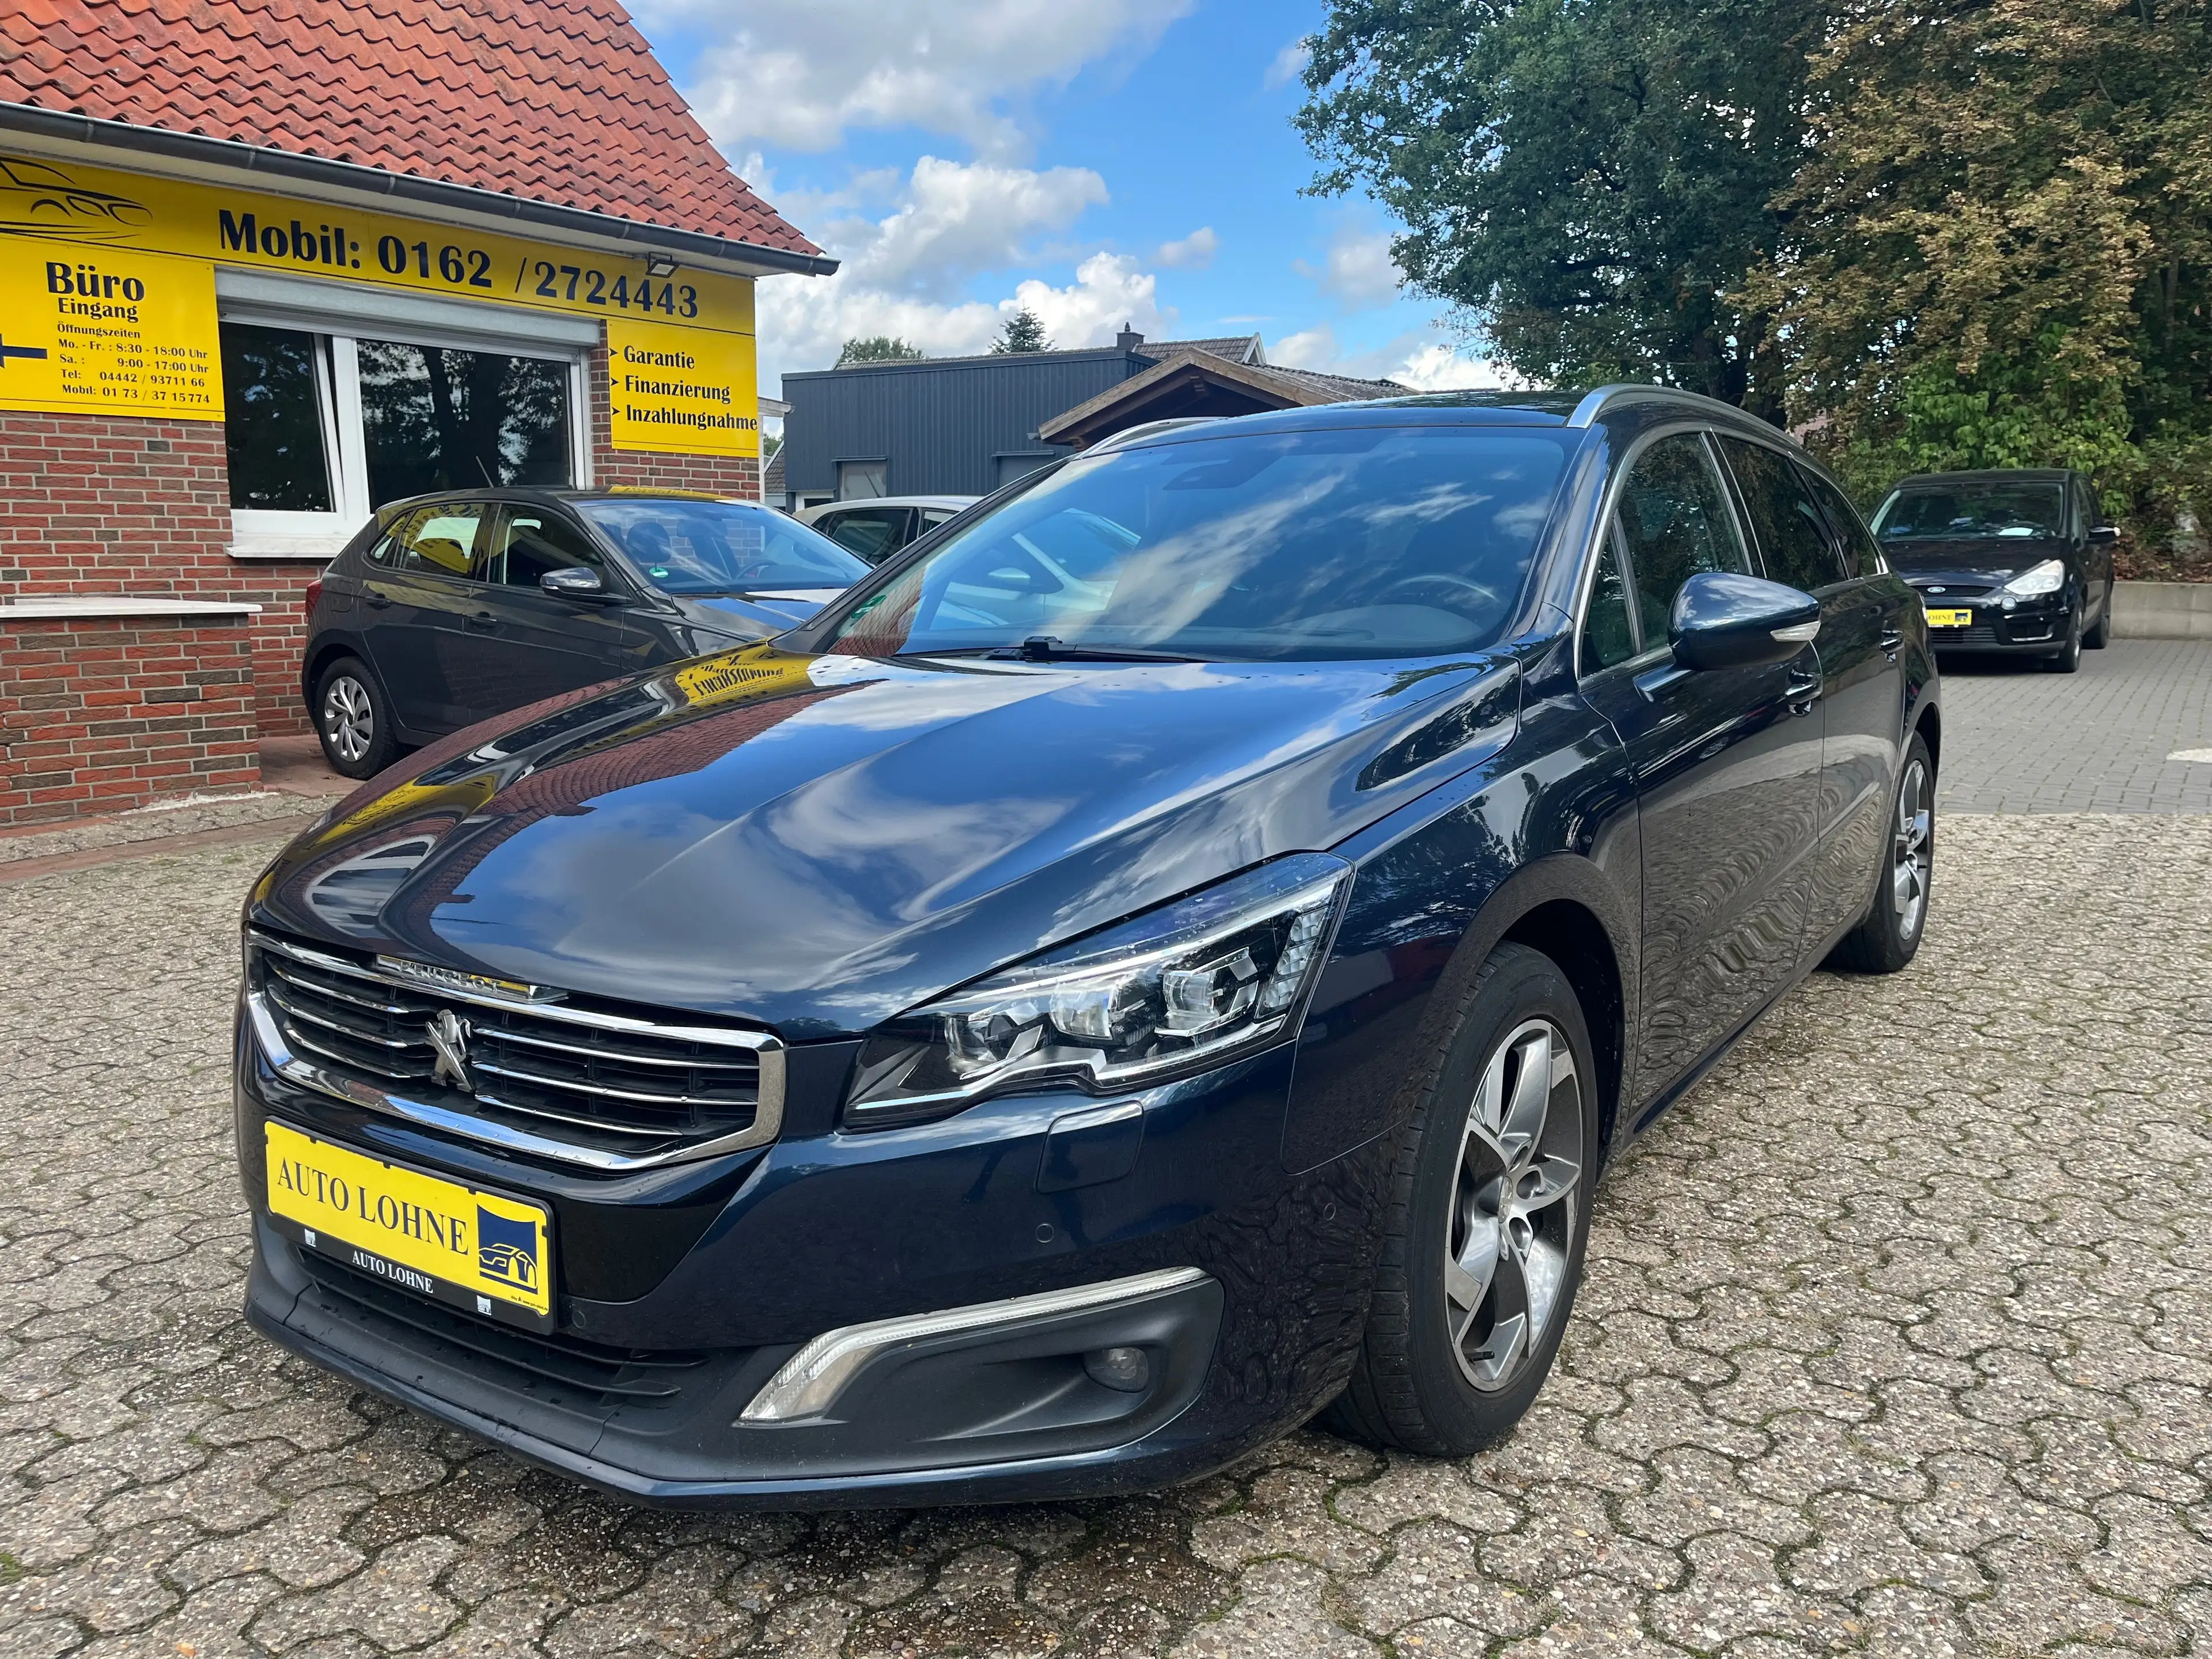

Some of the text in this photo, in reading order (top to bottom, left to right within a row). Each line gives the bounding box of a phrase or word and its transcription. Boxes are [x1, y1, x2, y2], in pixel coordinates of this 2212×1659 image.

[218, 209, 361, 270] Mobil:
[377, 235, 493, 288] 0162
[46, 261, 145, 302] Büro
[59, 297, 139, 323] Eingang
[58, 321, 141, 339] Öffnungszeiten
[59, 339, 78, 349] Mo.
[116, 343, 142, 354] 8:30
[154, 346, 185, 357] 18:00
[190, 349, 208, 359] Uhr
[624, 345, 695, 370] Garantie
[59, 354, 77, 364] Sa.
[118, 358, 143, 368] 9:00
[156, 361, 187, 372] 17:00
[190, 363, 209, 374] Uhr
[61, 369, 81, 379] Tel:
[100, 372, 138, 382] 04442
[150, 375, 185, 386] 93711
[191, 378, 205, 387] 66
[625, 375, 730, 404] Finanzierung
[62, 384, 96, 395] Mobil:
[103, 387, 116, 397] 01
[123, 388, 138, 399] 73
[152, 391, 166, 400] 37
[626, 404, 757, 431] Inzahlungnahme
[277, 1157, 469, 1256] AUTO LOHNE
[352, 1250, 434, 1294] AUTO LOHNE
